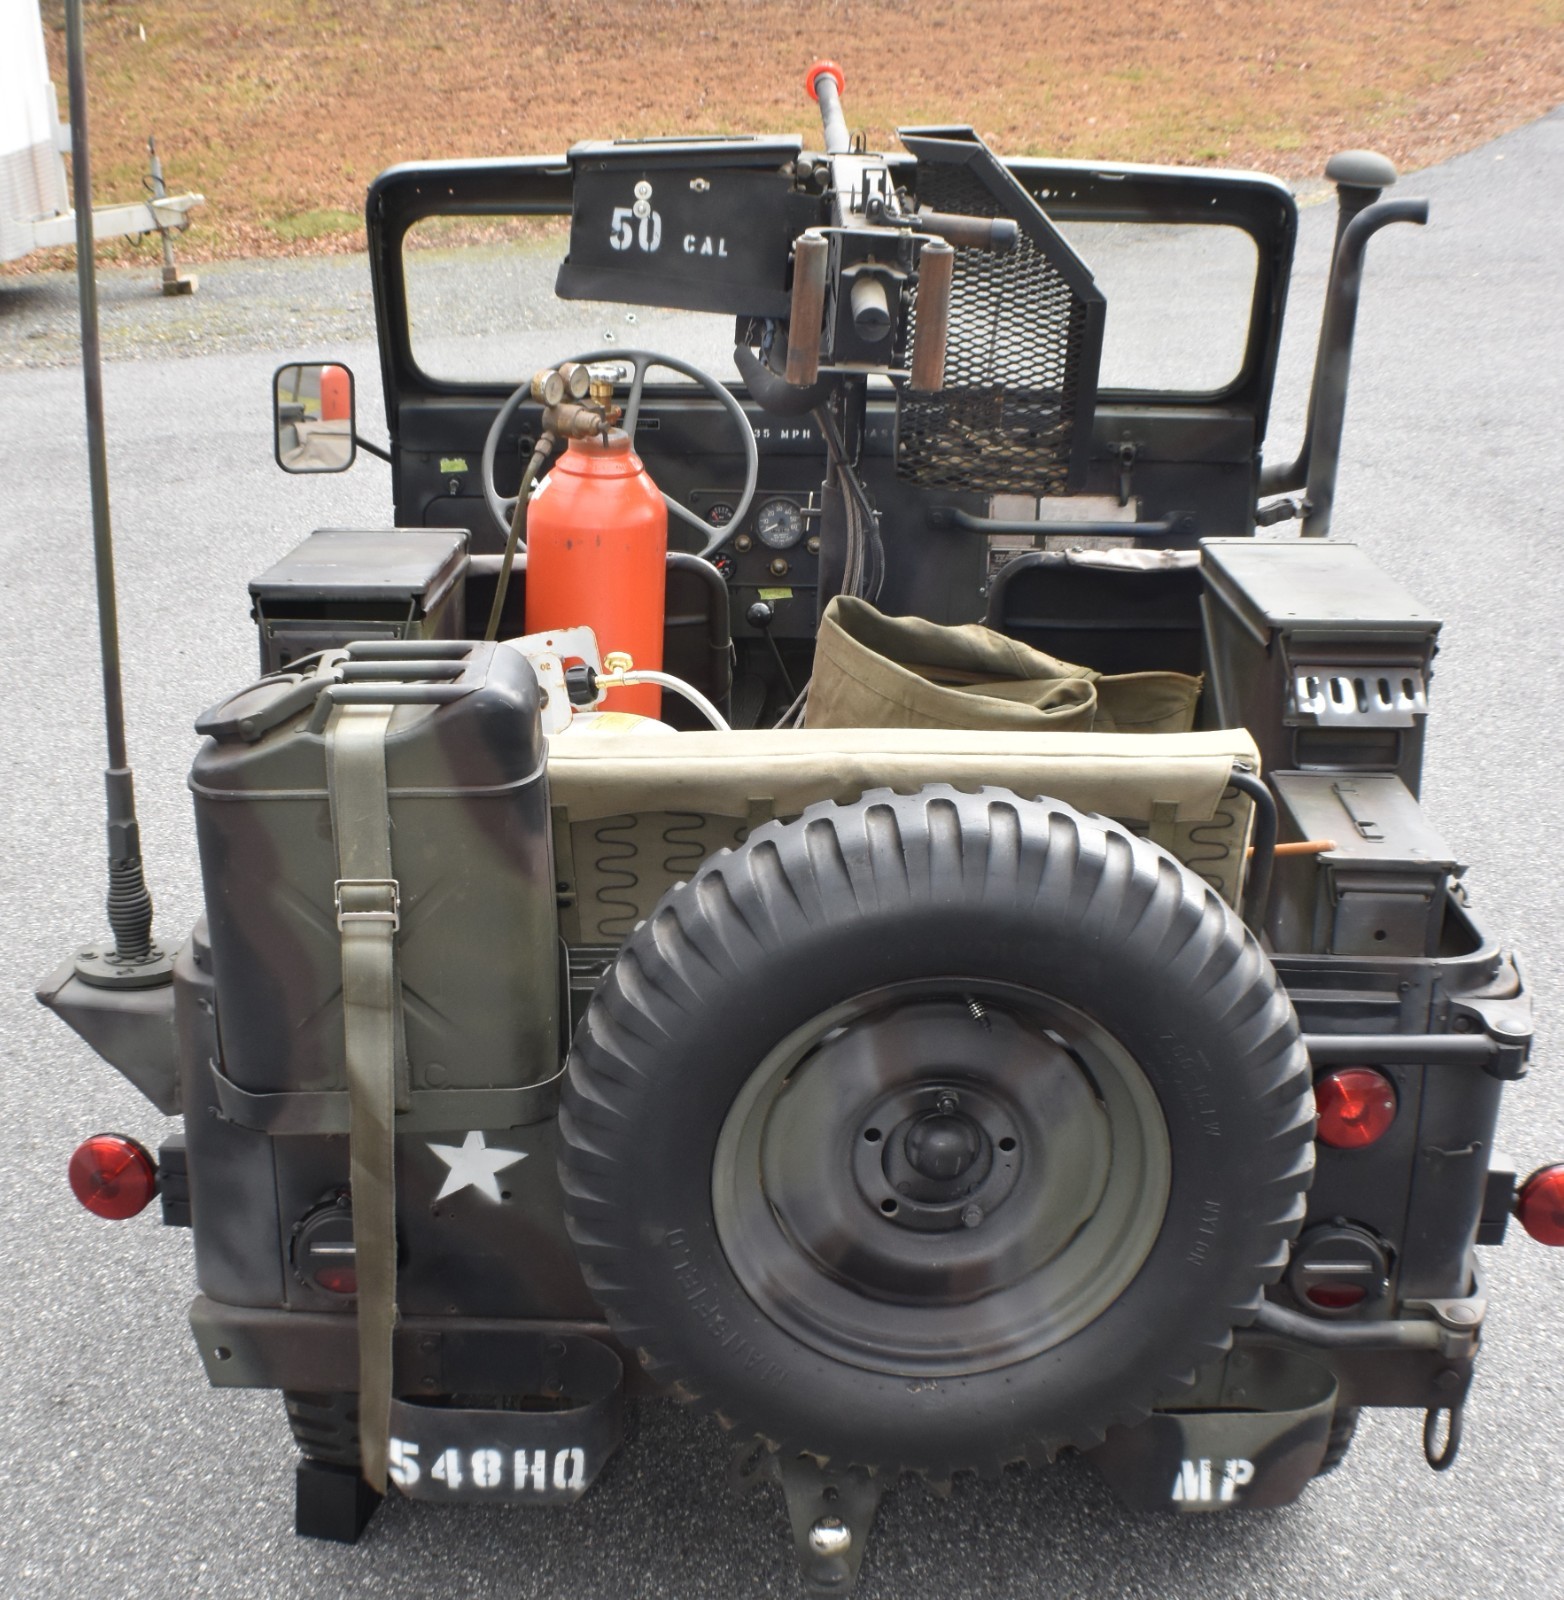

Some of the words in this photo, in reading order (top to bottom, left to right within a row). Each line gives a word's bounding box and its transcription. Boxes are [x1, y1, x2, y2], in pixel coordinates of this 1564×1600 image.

[609, 207, 662, 251] 50
[683, 234, 728, 257] CAL
[780, 429, 811, 439] MPH
[1171, 1458, 1255, 1501] MP
